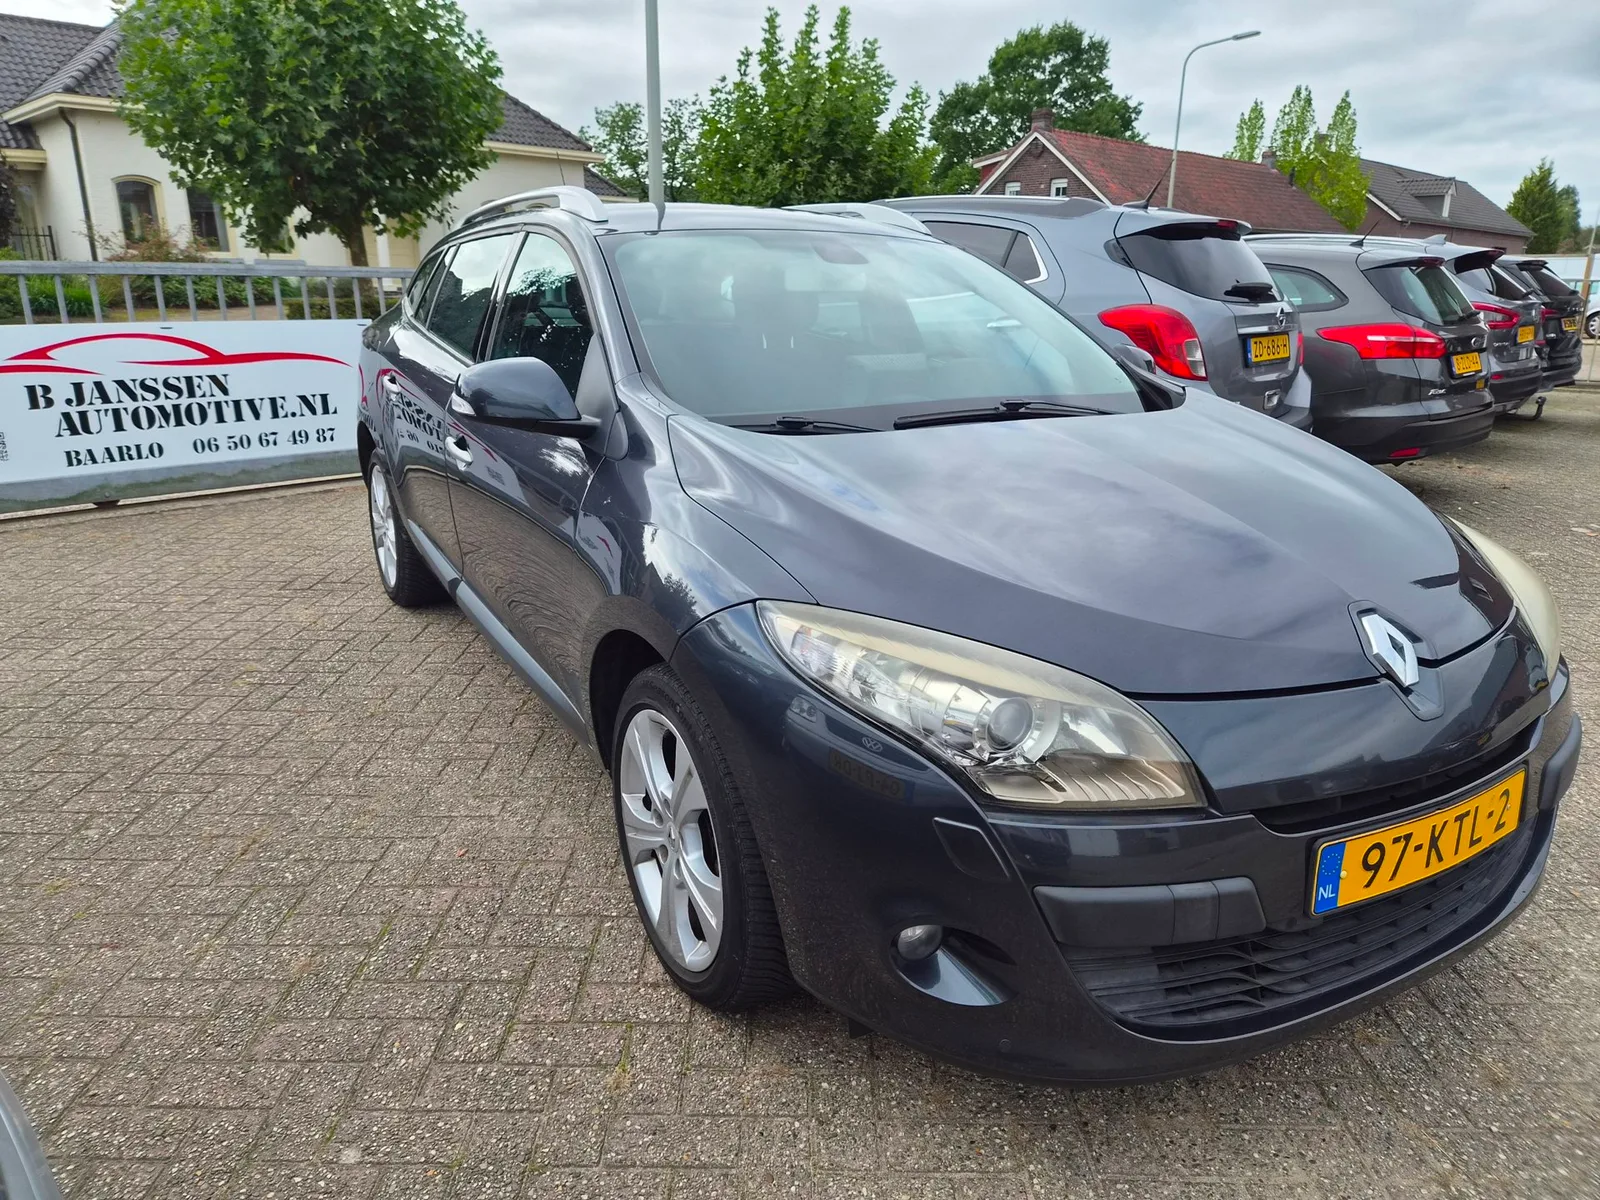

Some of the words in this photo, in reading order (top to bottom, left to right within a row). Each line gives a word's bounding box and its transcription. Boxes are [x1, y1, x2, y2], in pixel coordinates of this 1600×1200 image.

[1253, 338, 1288, 359] ZD-686-H
[24, 384, 55, 411] B
[64, 373, 231, 408] JANSSEN
[55, 393, 338, 438] AUTOMOTIVE.NL
[64, 441, 164, 468] BAARLO
[192, 437, 220, 454] 06
[227, 434, 252, 452] 50
[258, 431, 279, 449] 67
[287, 429, 310, 446] 49
[316, 427, 337, 444] 87
[1361, 788, 1510, 889] 97-KTL-2
[1317, 884, 1336, 901] NL
